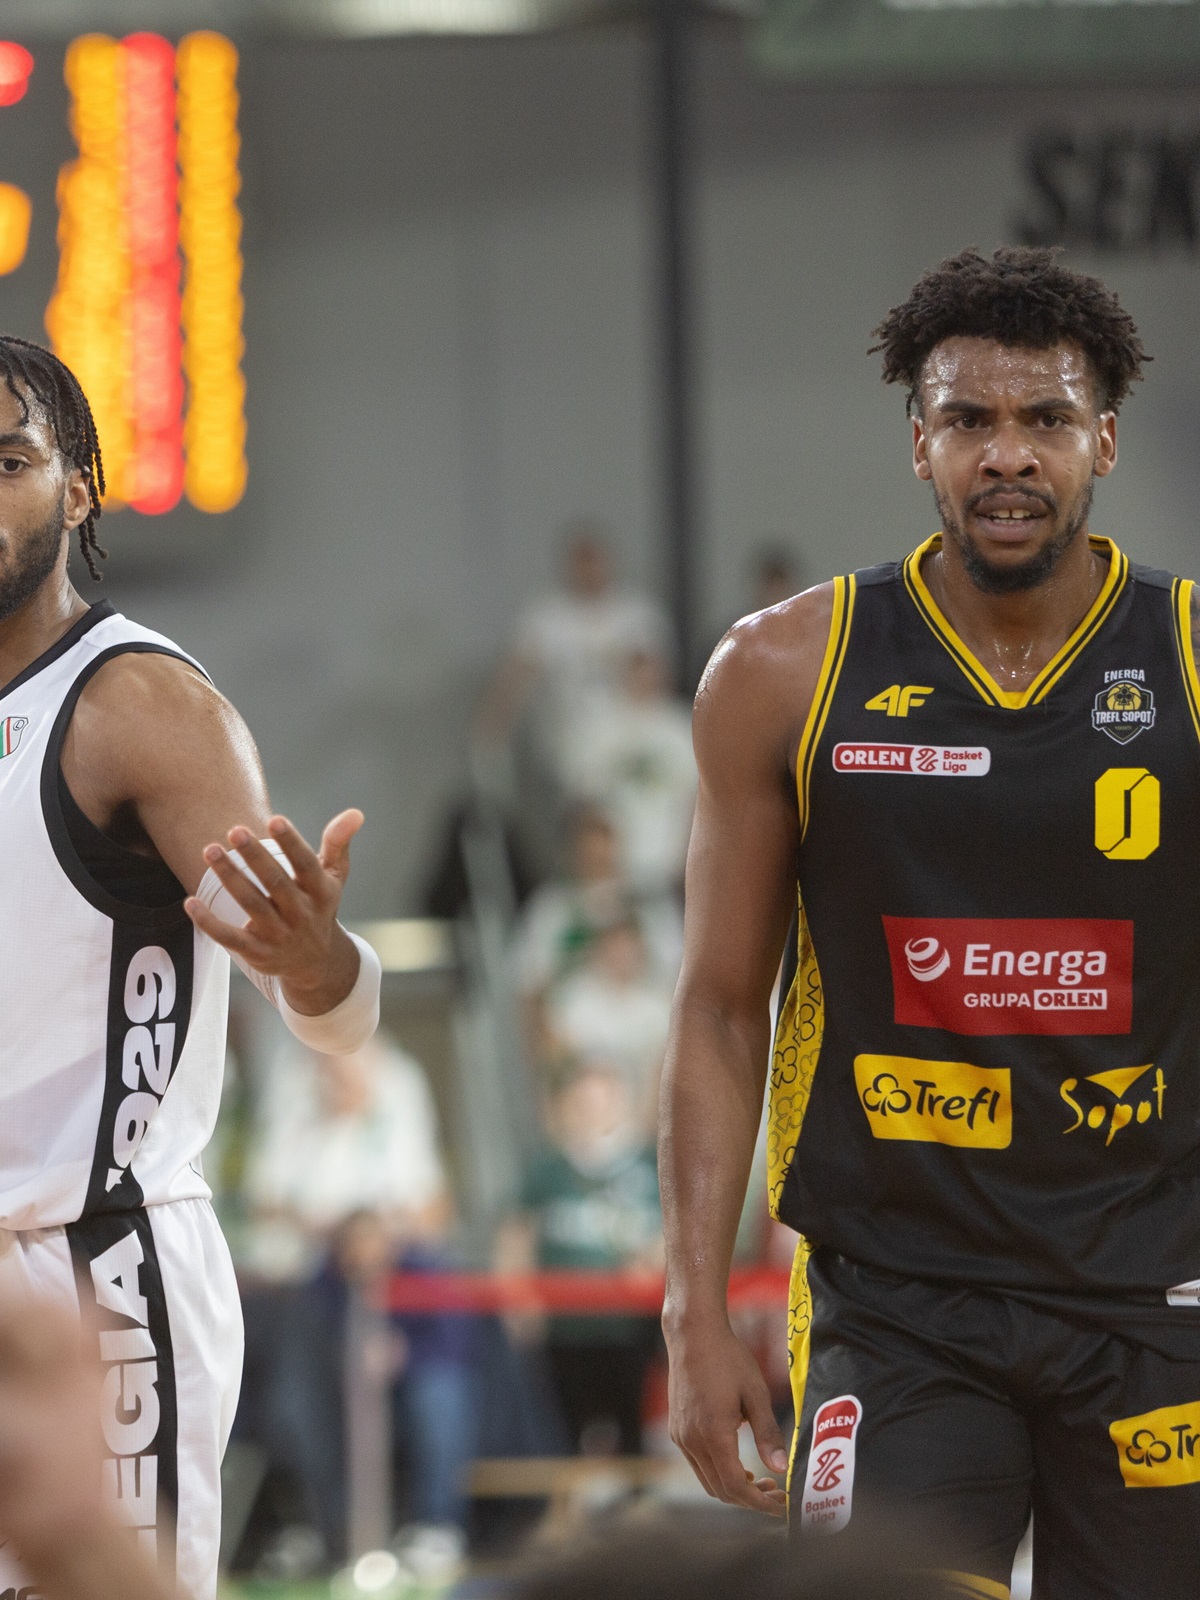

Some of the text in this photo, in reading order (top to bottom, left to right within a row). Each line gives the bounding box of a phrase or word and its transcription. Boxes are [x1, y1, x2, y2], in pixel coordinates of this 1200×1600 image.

[1104, 669, 1146, 684] ENERGA
[864, 684, 935, 718] 4F
[1095, 710, 1151, 725] TREFL SOPOT
[840, 749, 905, 767] ORLEN
[943, 750, 983, 761] Basket
[943, 761, 967, 773] Liga
[1094, 768, 1160, 860] 0
[963, 943, 1108, 986] Energa
[963, 991, 1104, 1008] GRUPA ORLEN
[913, 1079, 1001, 1131] Trefl
[1059, 1064, 1168, 1147] Sopot
[818, 1415, 855, 1433] ORLEN
[805, 1495, 846, 1514] Basket
